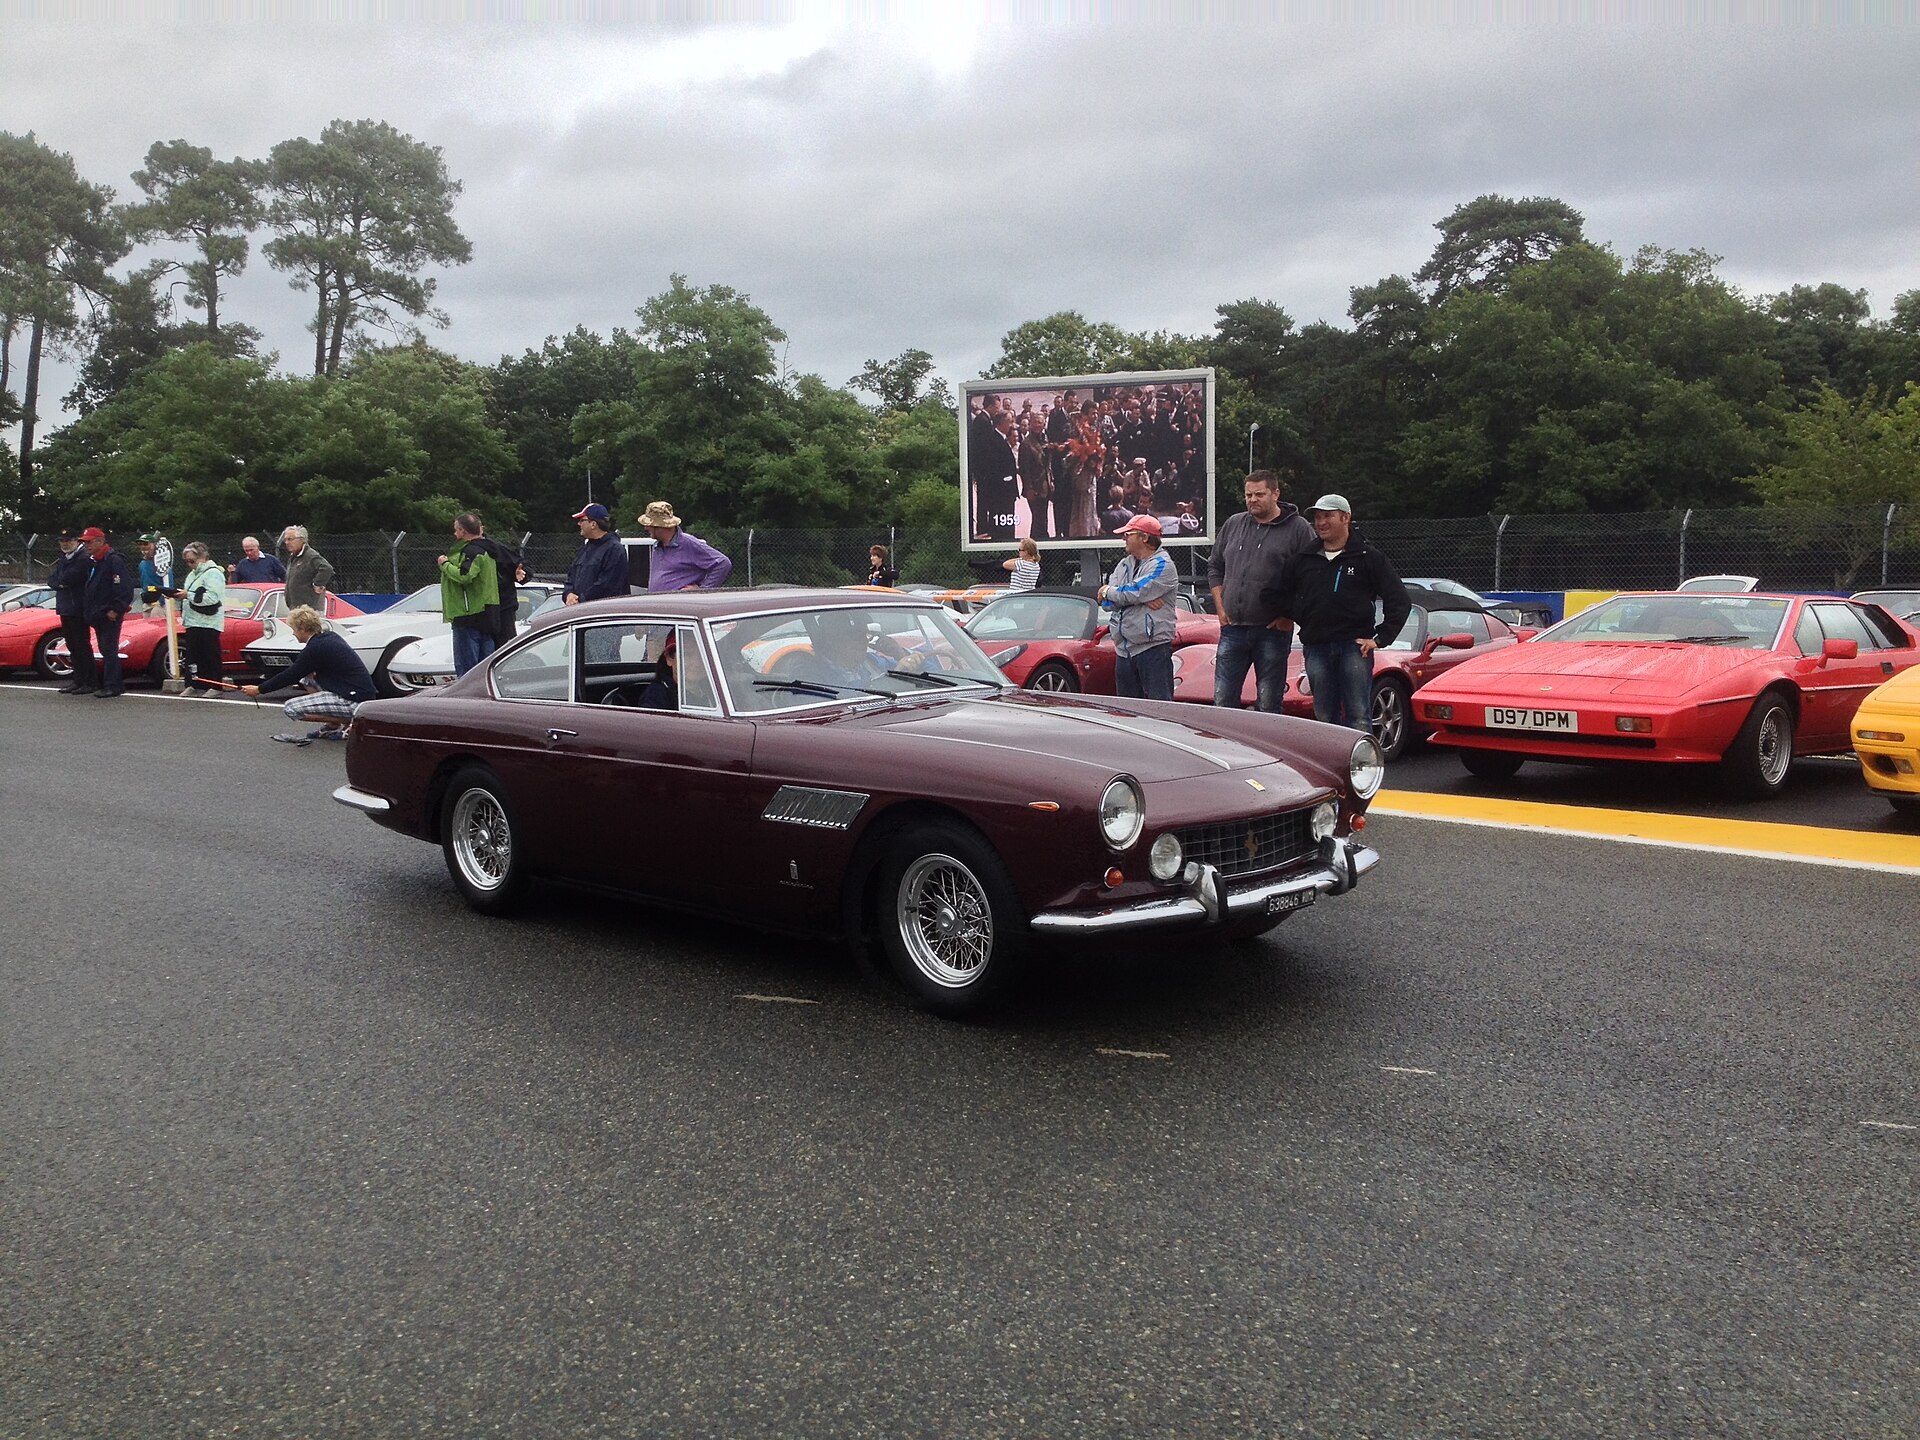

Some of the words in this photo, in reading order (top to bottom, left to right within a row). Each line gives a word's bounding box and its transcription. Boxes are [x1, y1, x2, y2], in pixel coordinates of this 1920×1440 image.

[993, 514, 1020, 526] 1959
[1493, 708, 1528, 725] D97
[1533, 711, 1569, 728] DPM
